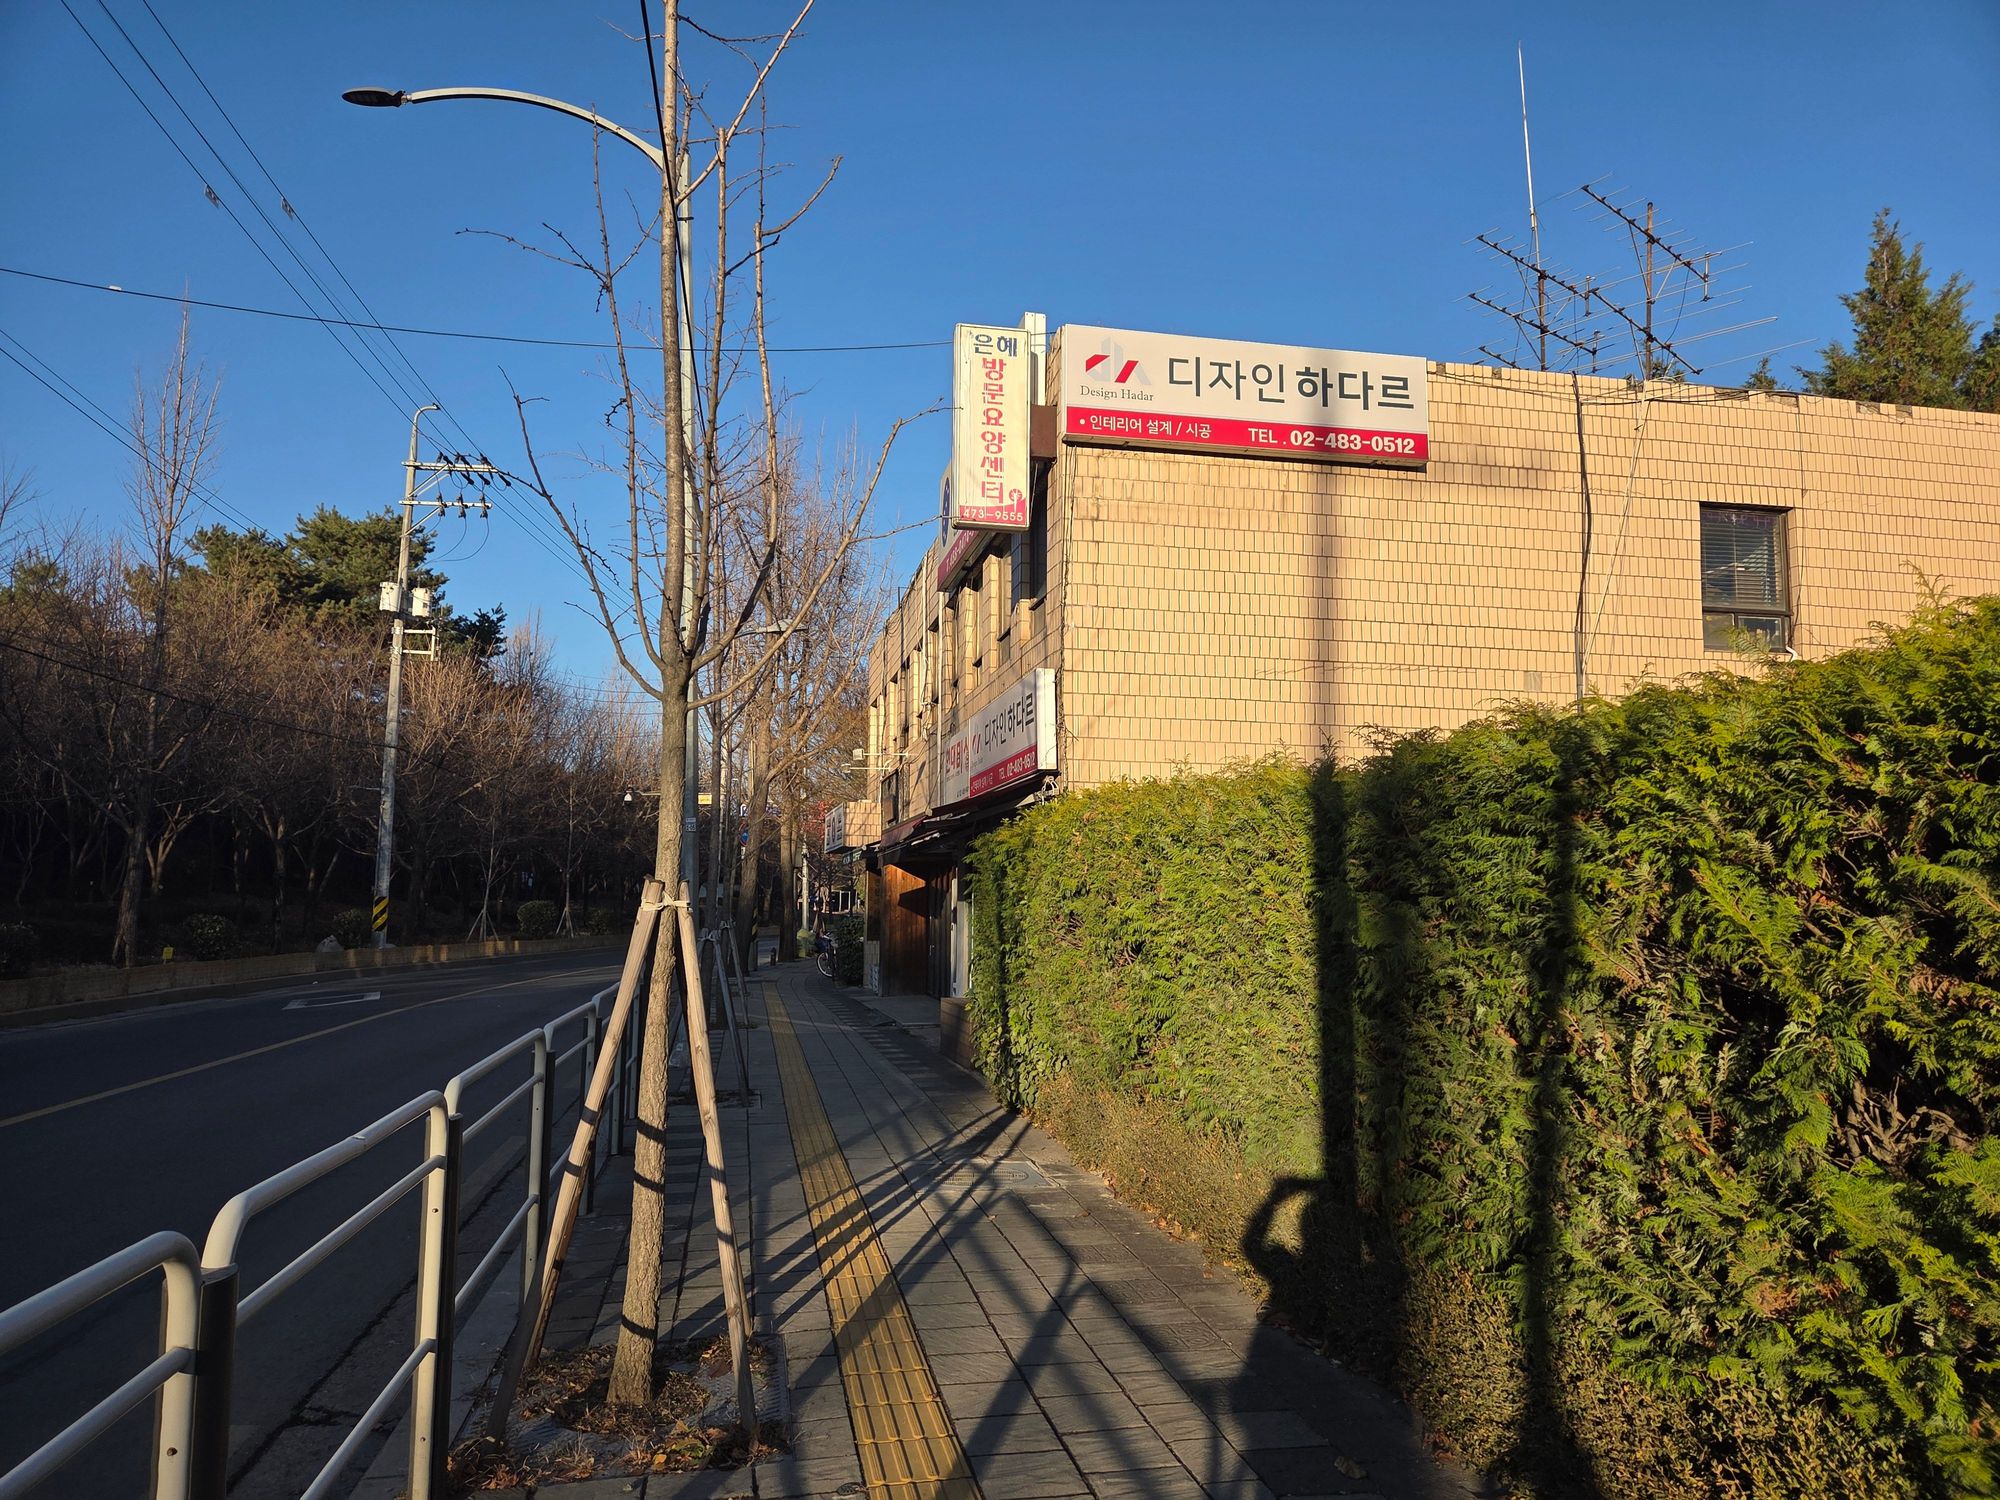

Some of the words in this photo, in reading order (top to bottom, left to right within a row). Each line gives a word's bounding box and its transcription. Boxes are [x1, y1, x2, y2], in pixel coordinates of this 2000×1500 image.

[974, 334, 1018, 358] 은혜
[1080, 385, 1118, 400] Design
[1121, 388, 1154, 402] Hadar
[981, 357, 1006, 504] 방문요양센터
[1090, 415, 1142, 433] 인테리어
[1146, 419, 1172, 436] 설계
[1186, 422, 1212, 439] 시공
[1290, 429, 1415, 454] 02-483-0512
[963, 508, 1024, 522] 473-9555
